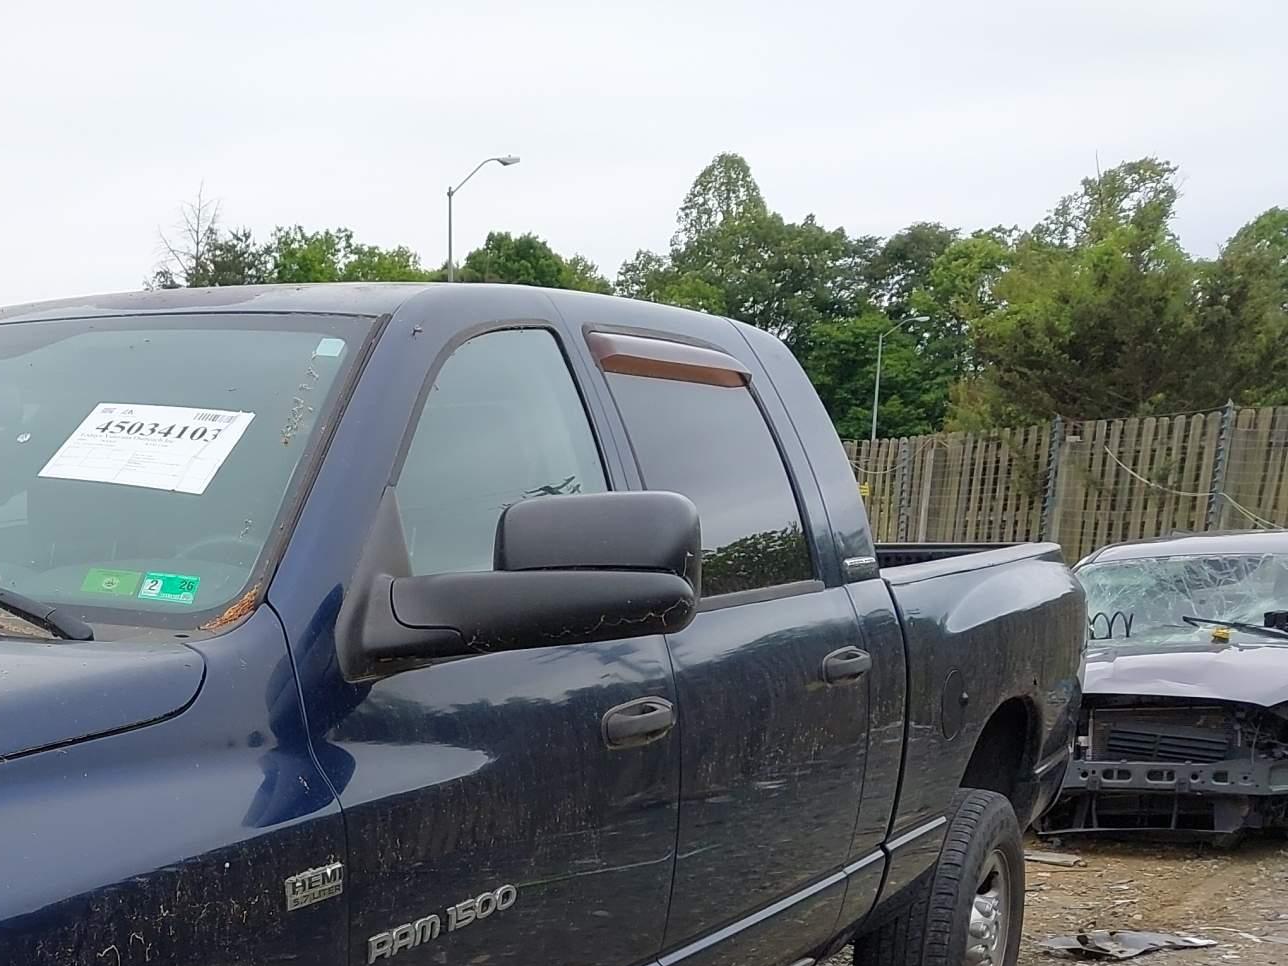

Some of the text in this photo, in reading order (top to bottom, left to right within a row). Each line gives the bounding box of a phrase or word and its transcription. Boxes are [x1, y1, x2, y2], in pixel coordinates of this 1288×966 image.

[95, 419, 223, 443] 45034103
[148, 580, 159, 592] 2
[179, 580, 194, 592] 26
[292, 866, 343, 896] HEMI
[312, 883, 342, 901] LITER
[368, 884, 518, 965] RAM 1500
